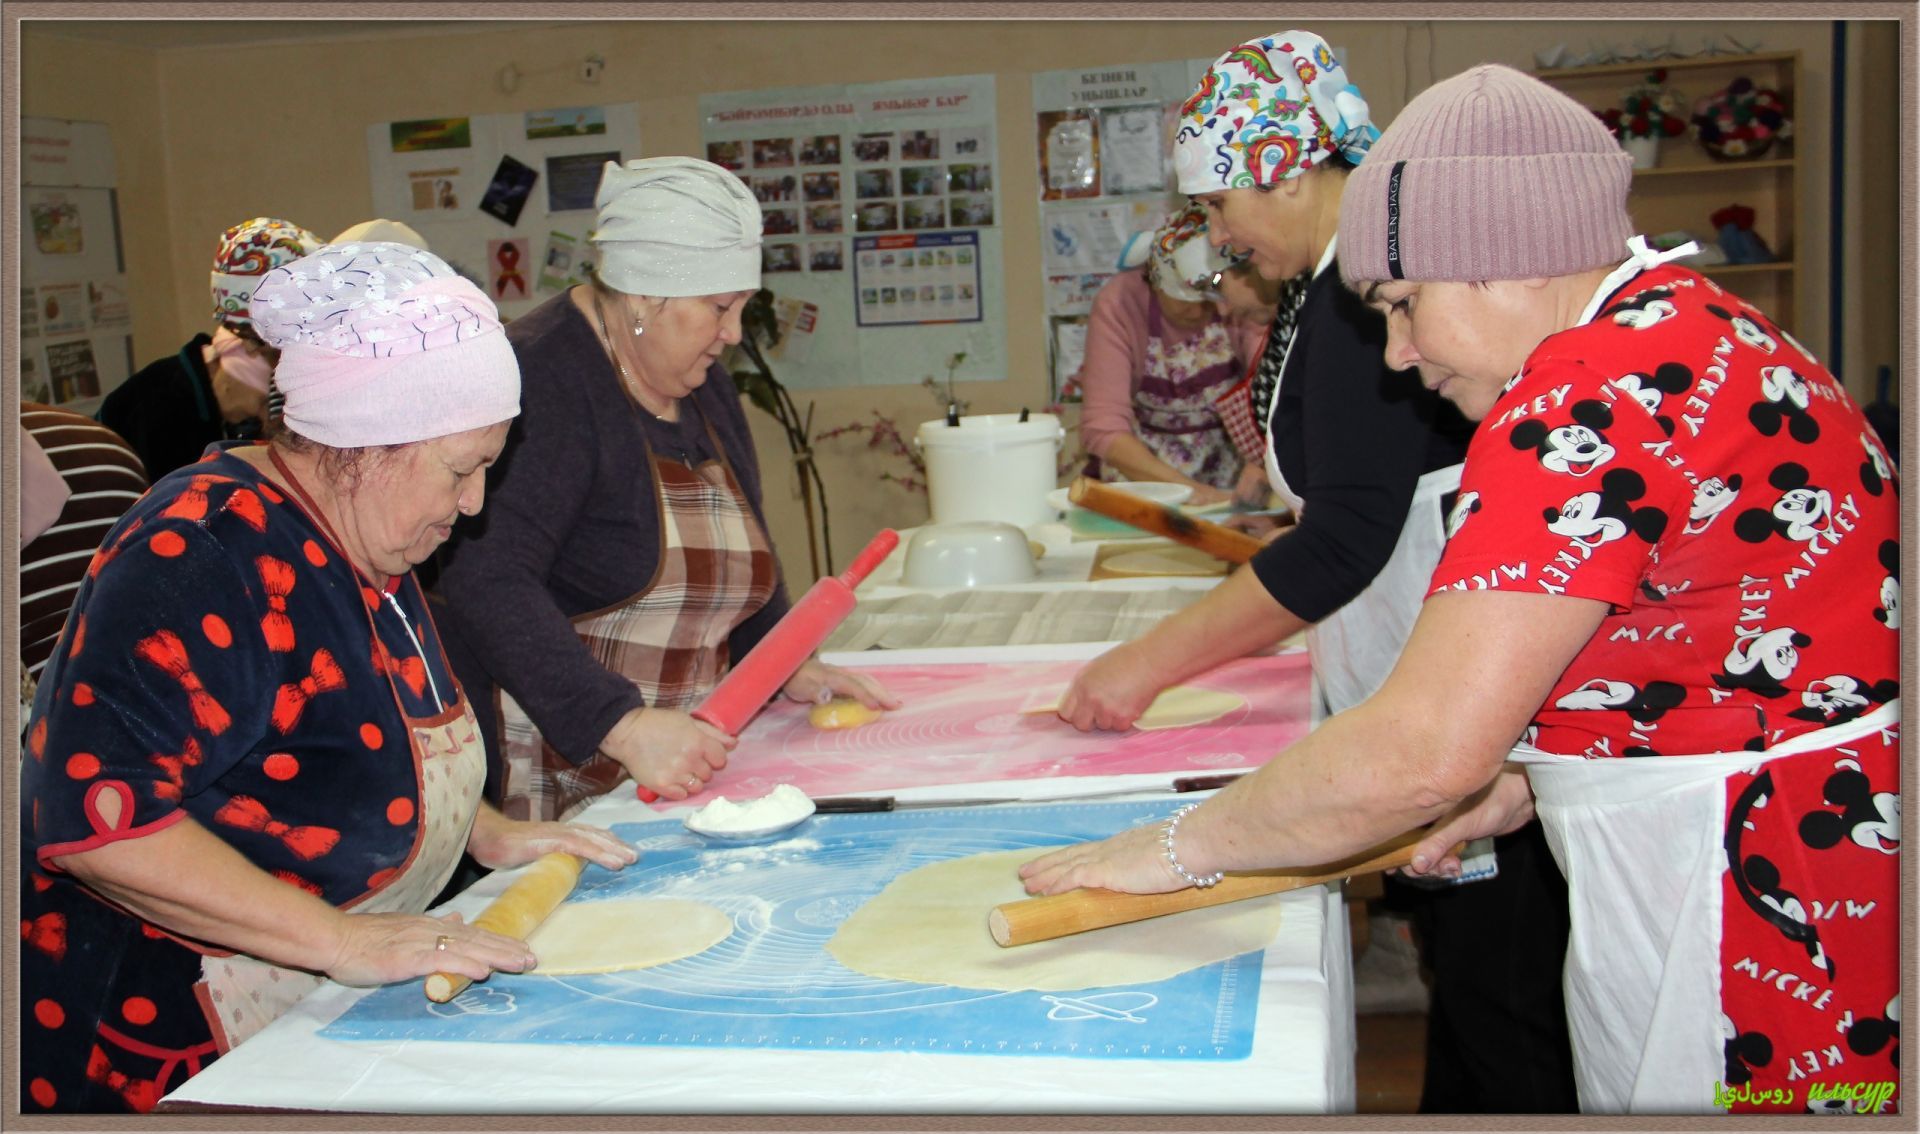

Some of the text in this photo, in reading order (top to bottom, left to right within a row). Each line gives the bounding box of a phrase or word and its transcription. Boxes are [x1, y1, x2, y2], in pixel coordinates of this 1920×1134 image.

[1388, 173, 1400, 261] BALENCIAGA
[1681, 335, 1735, 437] MICKEY
[1783, 493, 1860, 590] MICKEY
